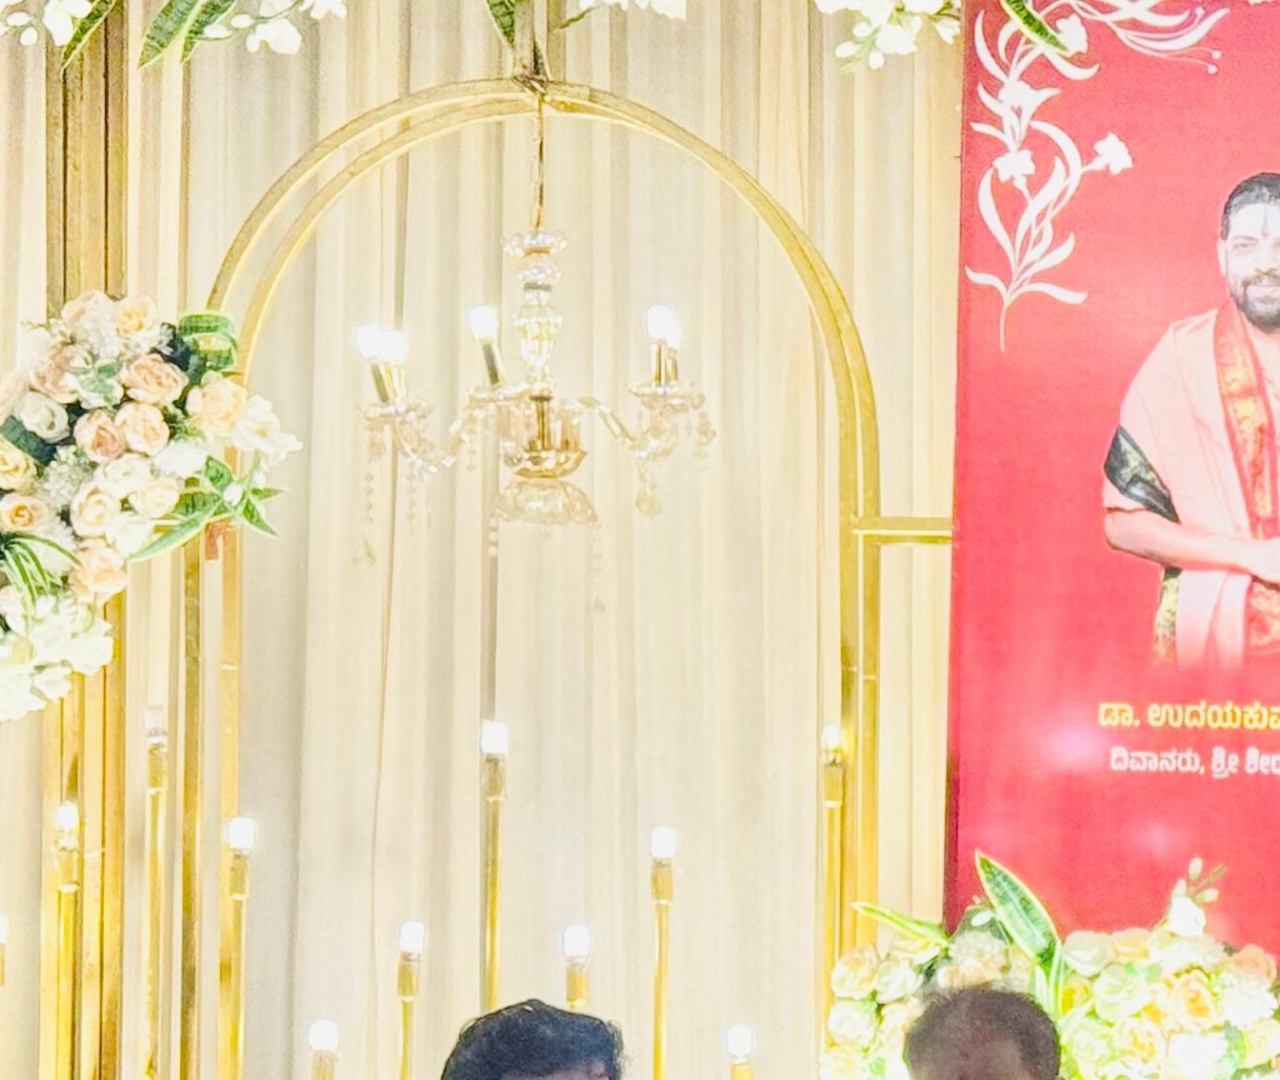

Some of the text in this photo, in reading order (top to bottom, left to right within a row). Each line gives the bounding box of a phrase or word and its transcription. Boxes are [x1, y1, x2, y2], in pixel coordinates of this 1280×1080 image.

[1098, 701, 1141, 728] ಡಾ.
[1109, 745, 1206, 776] ದಿವಾನರು,
[1210, 744, 1240, 780] ಶ್ರೀ
